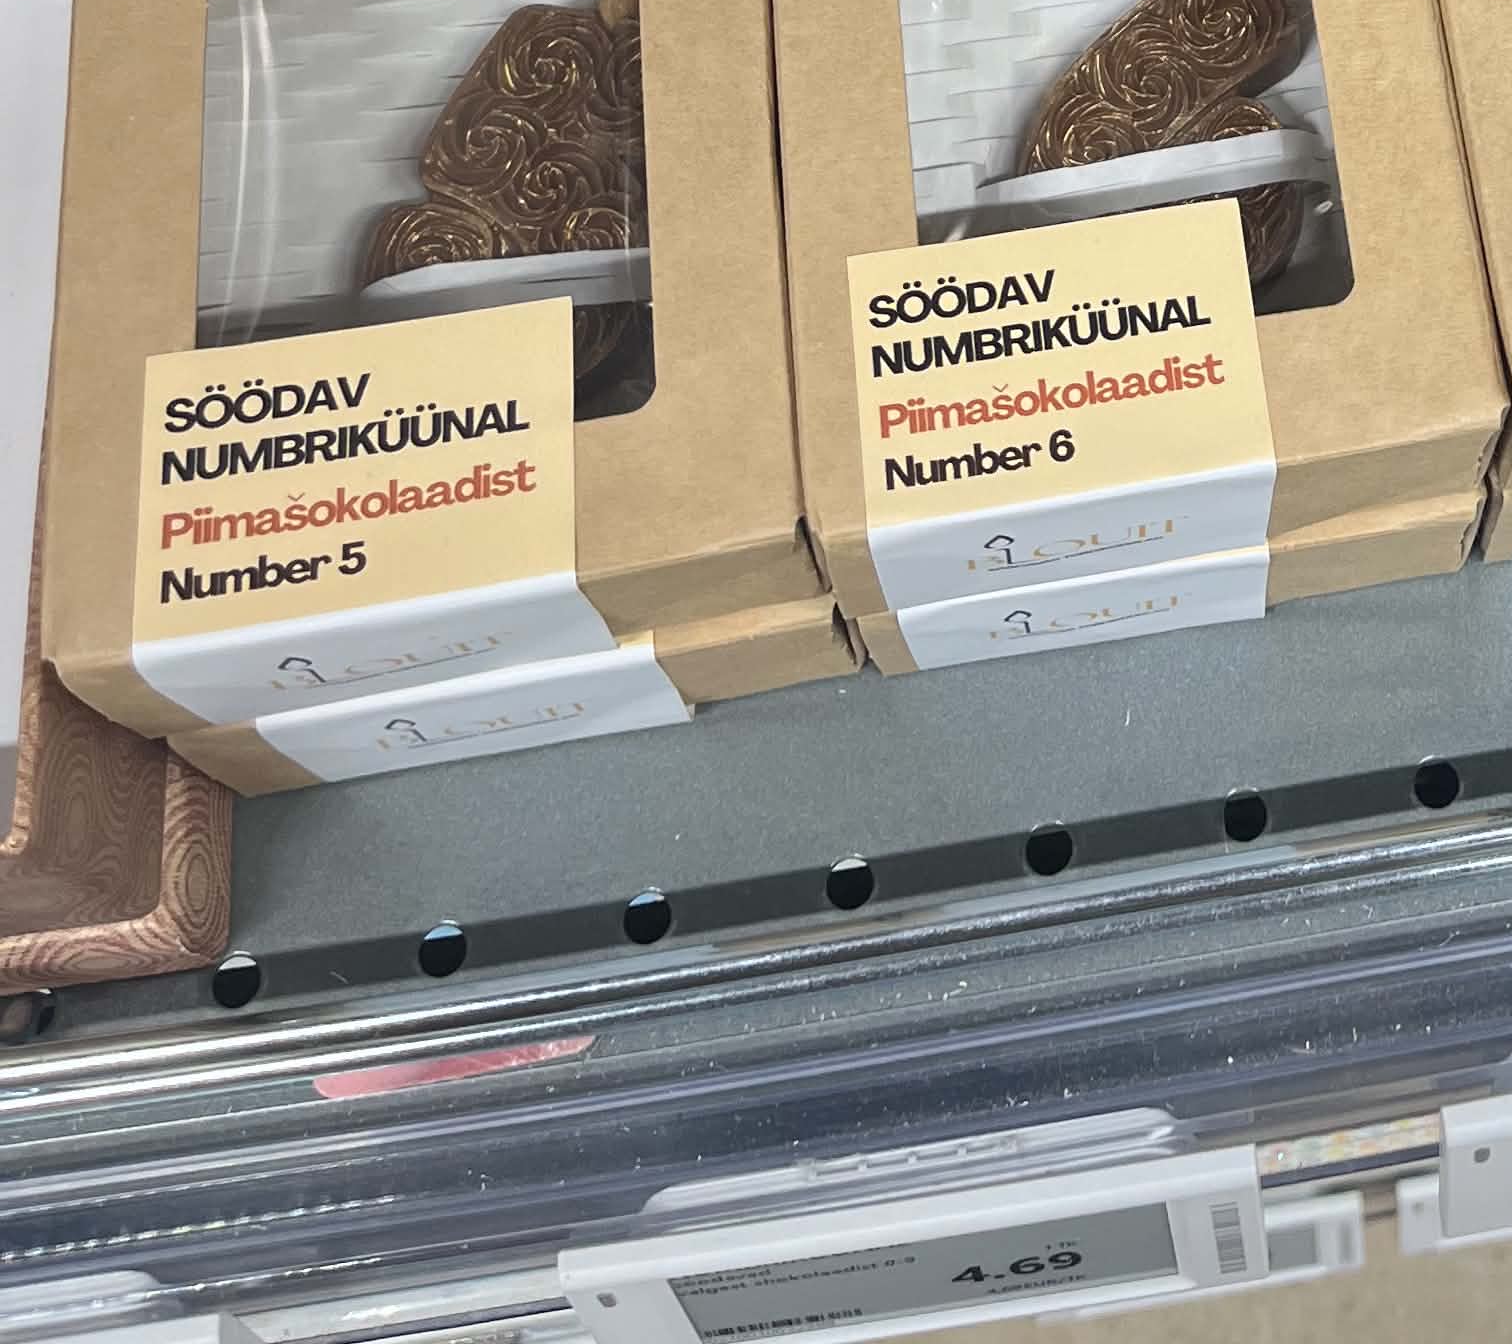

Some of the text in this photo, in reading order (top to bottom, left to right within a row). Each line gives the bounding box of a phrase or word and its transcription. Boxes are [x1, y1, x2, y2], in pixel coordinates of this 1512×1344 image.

[868, 268, 1056, 329] SÖÖDAV
[871, 295, 1212, 379] NUMBRIKÜÜNAL
[163, 372, 371, 434] SÖÖDAV
[879, 353, 1225, 439] Piimašokolaadist
[160, 399, 531, 486] NUMBRIKÜÜNAL
[884, 428, 1076, 491] Number 6
[160, 459, 537, 550] Piimašokolaadist
[160, 540, 367, 605] Number 5
[951, 1251, 1083, 1283] 4.69
